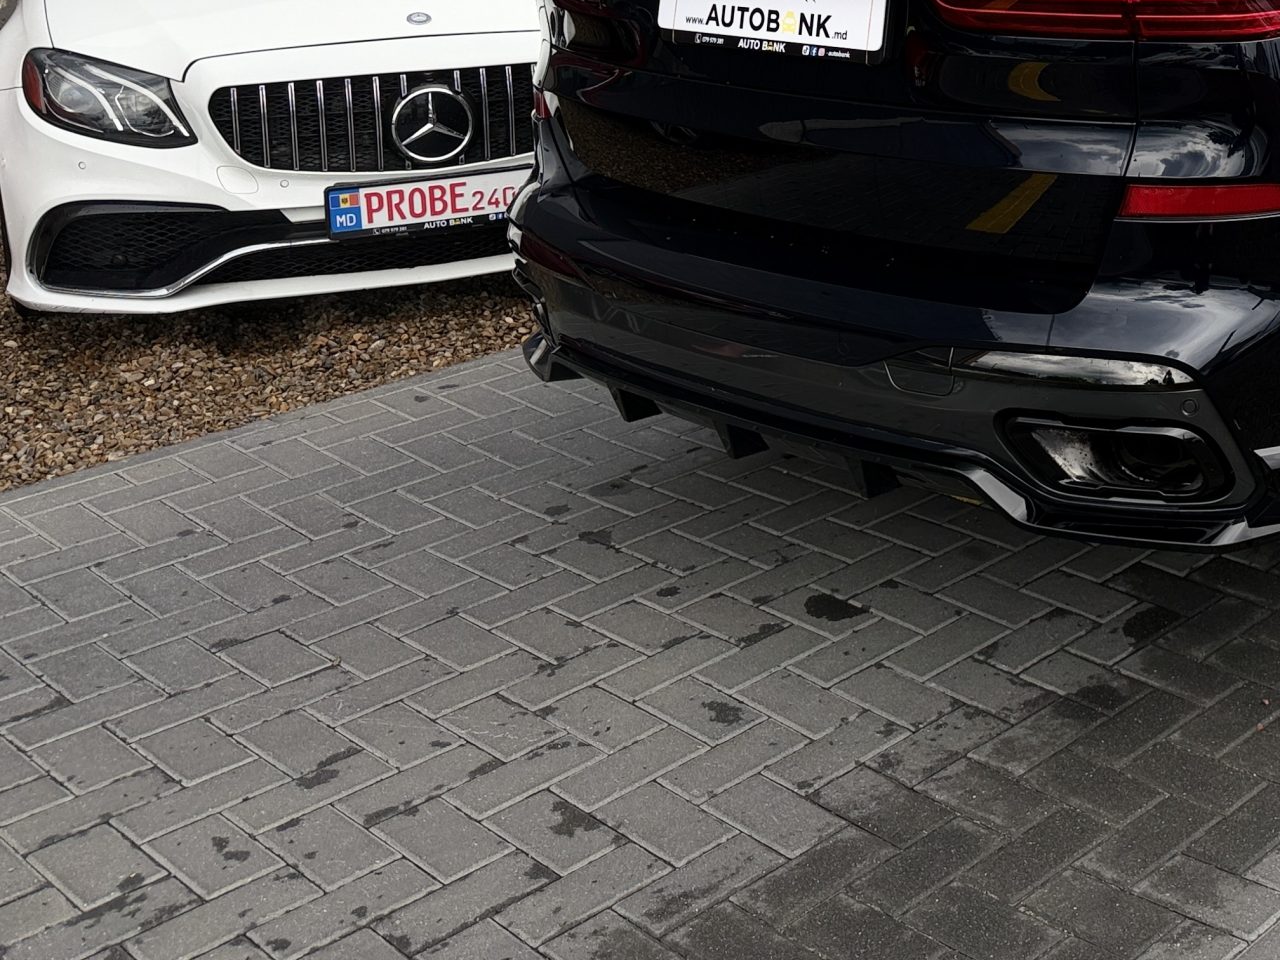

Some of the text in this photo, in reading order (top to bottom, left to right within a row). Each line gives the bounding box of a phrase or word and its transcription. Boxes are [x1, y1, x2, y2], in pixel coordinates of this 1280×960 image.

[737, 38, 761, 50] AUTO
[364, 182, 469, 225] PROBE
[335, 213, 357, 228] MD
[423, 219, 447, 230] AUTO
